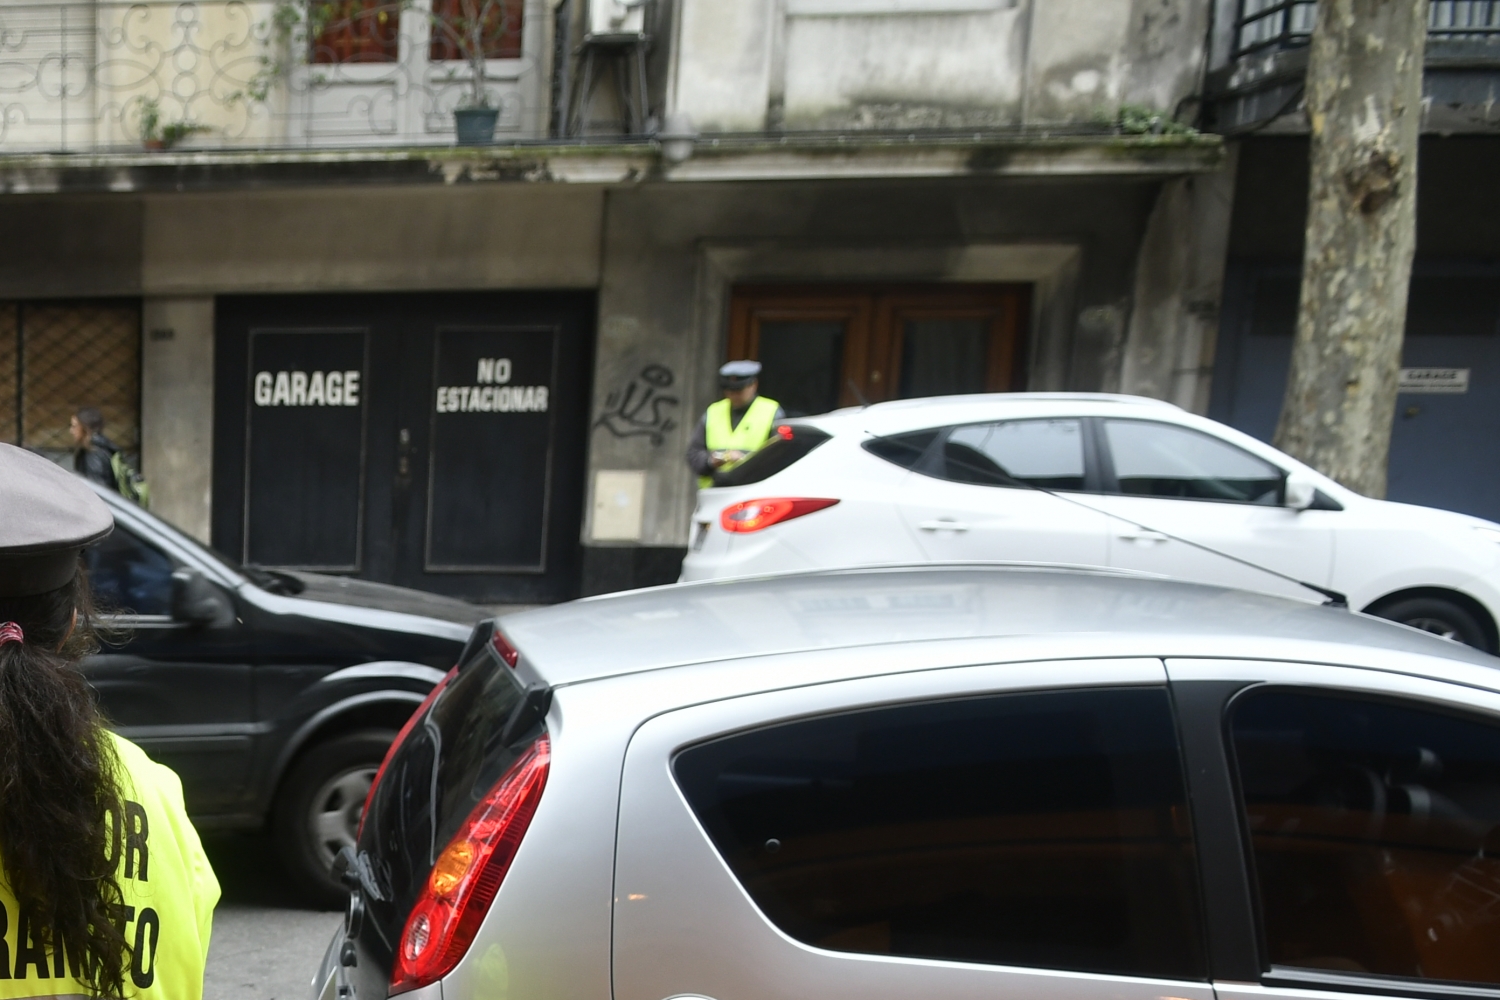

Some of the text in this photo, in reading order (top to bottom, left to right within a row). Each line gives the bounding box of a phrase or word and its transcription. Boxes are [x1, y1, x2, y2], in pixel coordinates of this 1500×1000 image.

[476, 358, 512, 384] NO
[253, 370, 360, 407] GARAGE
[436, 386, 549, 414] ESTACIONAR
